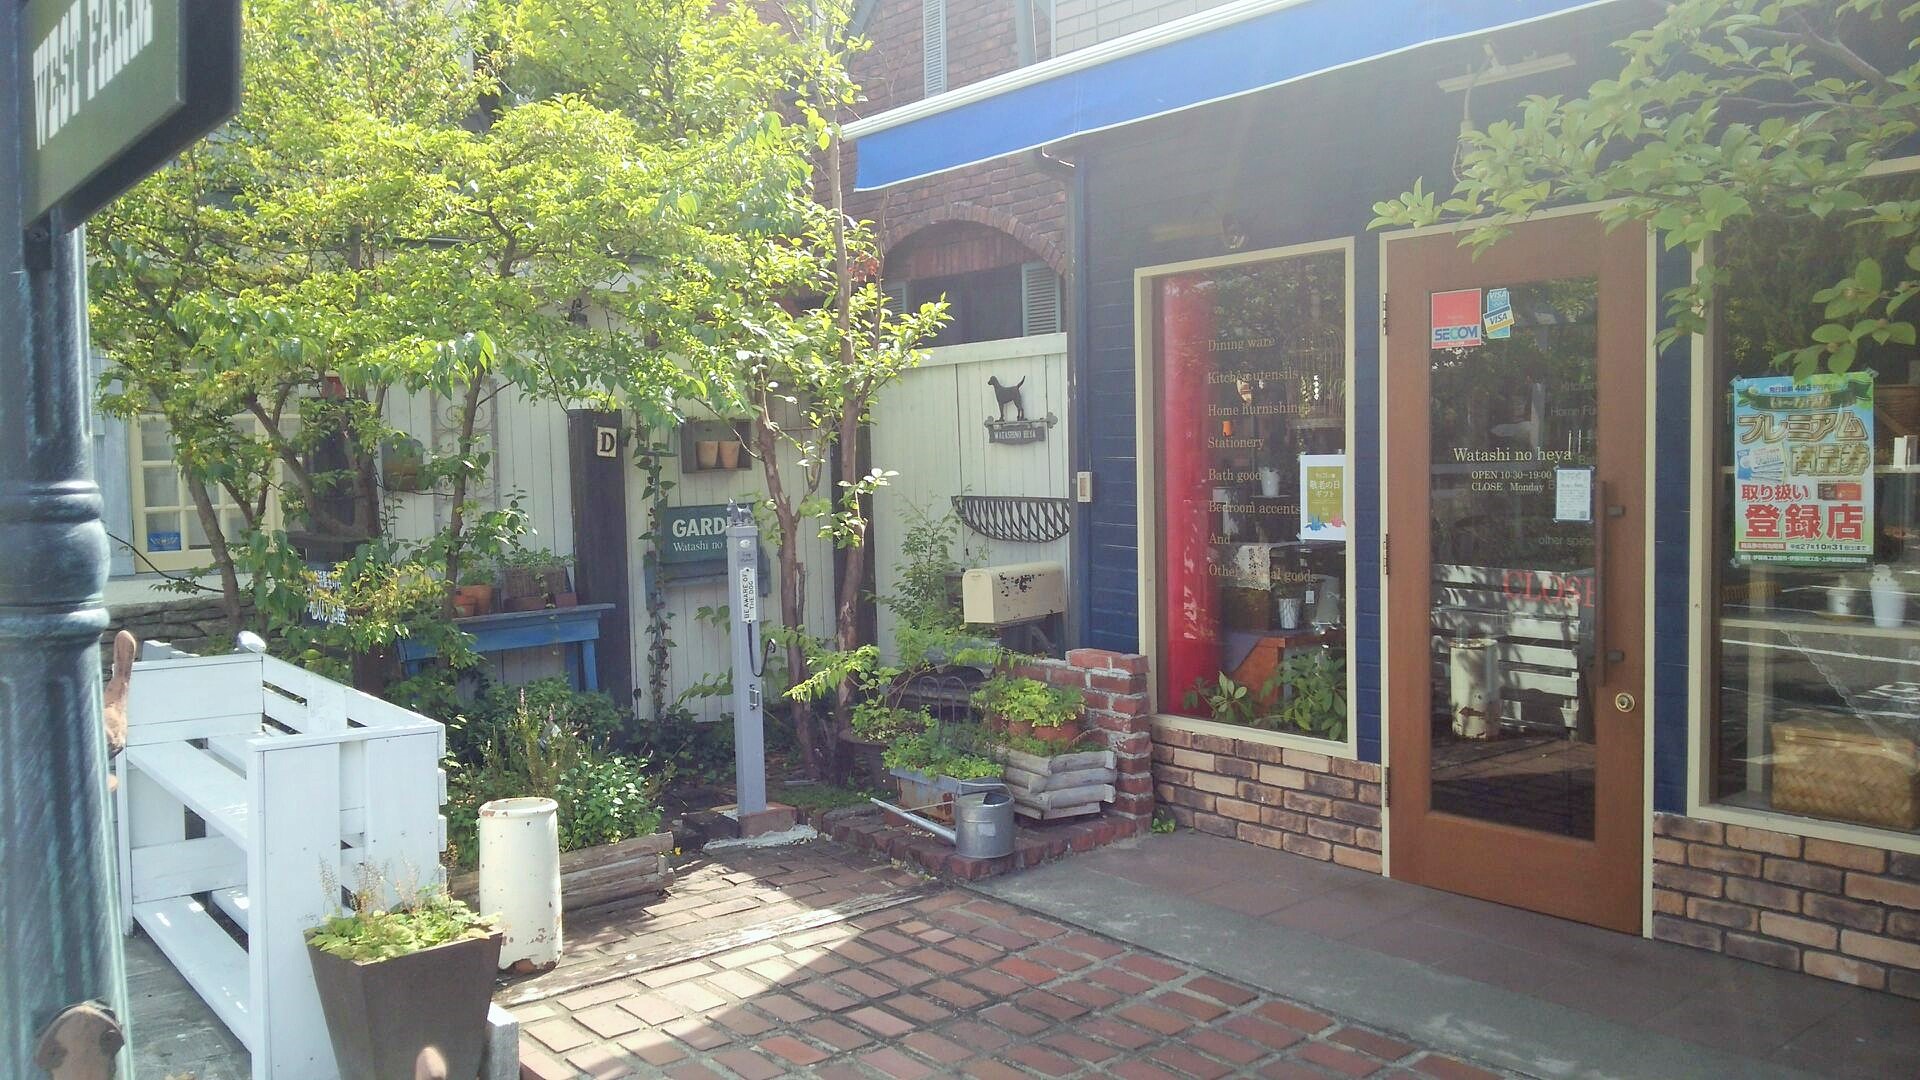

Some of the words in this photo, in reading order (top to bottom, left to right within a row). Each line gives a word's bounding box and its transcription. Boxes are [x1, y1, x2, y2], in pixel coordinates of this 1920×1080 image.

[33, 0, 81, 150] WEST
[87, 0, 153, 101] FARM
[1489, 312, 1508, 325] VISA
[1434, 326, 1478, 341] SECOM
[1208, 339, 1244, 351] Dining
[1248, 337, 1275, 347] ware
[1253, 366, 1299, 381] utensils
[1208, 404, 1239, 416] Home
[1738, 411, 1868, 444] プレミアム
[600, 431, 616, 453] D
[1208, 436, 1265, 450] Stationery
[1453, 447, 1511, 462] Watashi
[1515, 451, 1533, 461] no
[1537, 447, 1572, 464] heya
[1791, 444, 1871, 476] 商品券
[1208, 468, 1234, 481] Bath
[1471, 470, 1499, 480] OPEN
[1471, 482, 1504, 492] CLOSE
[1510, 482, 1545, 493] Monday
[1741, 484, 1809, 502] 取り扱い
[1208, 501, 1257, 513] Bedroom
[1259, 503, 1300, 515] accents
[672, 517, 727, 538] GARD
[1744, 503, 1865, 541] 登録店
[1208, 533, 1231, 545] And
[1284, 569, 1318, 584] goods
